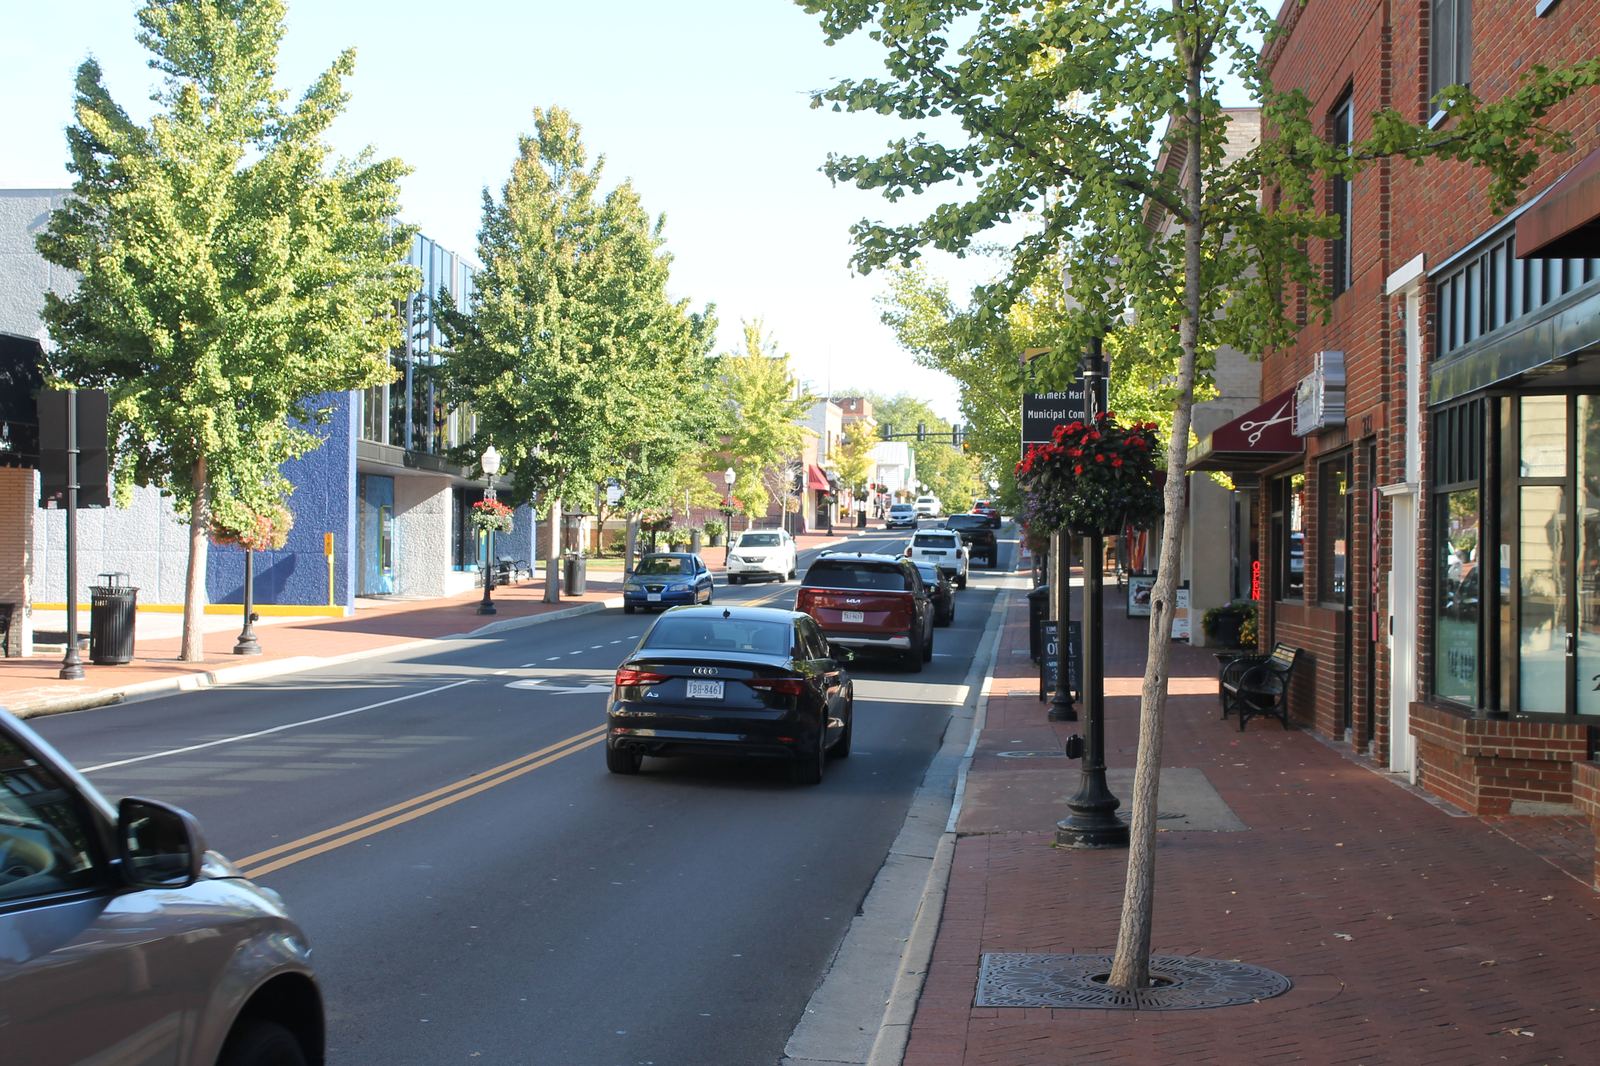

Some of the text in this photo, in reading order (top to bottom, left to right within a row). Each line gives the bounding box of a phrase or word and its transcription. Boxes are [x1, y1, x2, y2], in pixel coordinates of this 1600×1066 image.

[1069, 391, 1086, 400] Mar
[1028, 409, 1085, 421] Municipal Com
[1252, 560, 1261, 601] OPEN
